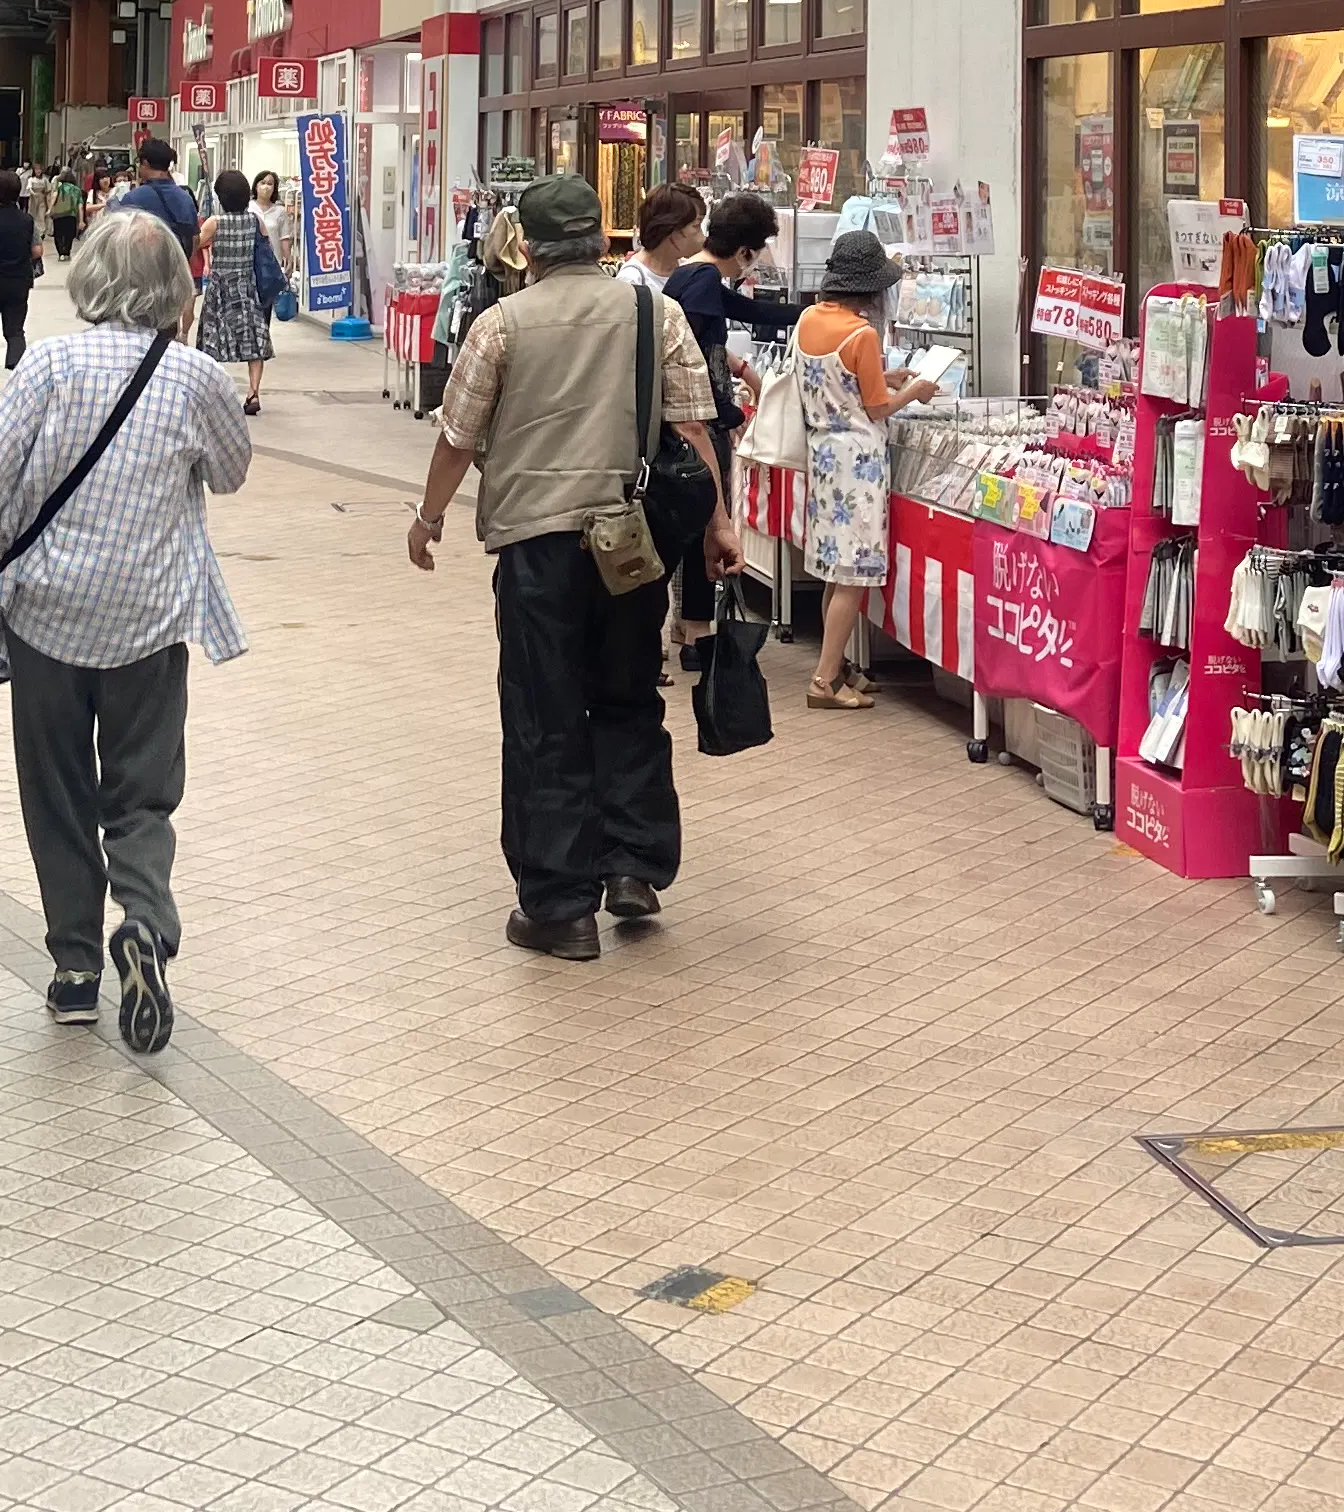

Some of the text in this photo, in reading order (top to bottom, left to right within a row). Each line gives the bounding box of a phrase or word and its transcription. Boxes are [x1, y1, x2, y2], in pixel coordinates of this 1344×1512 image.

[278, 68, 299, 89] 薬
[196, 89, 212, 106] 薬
[140, 104, 154, 117] 薬
[993, 540, 1060, 602] 脱げない
